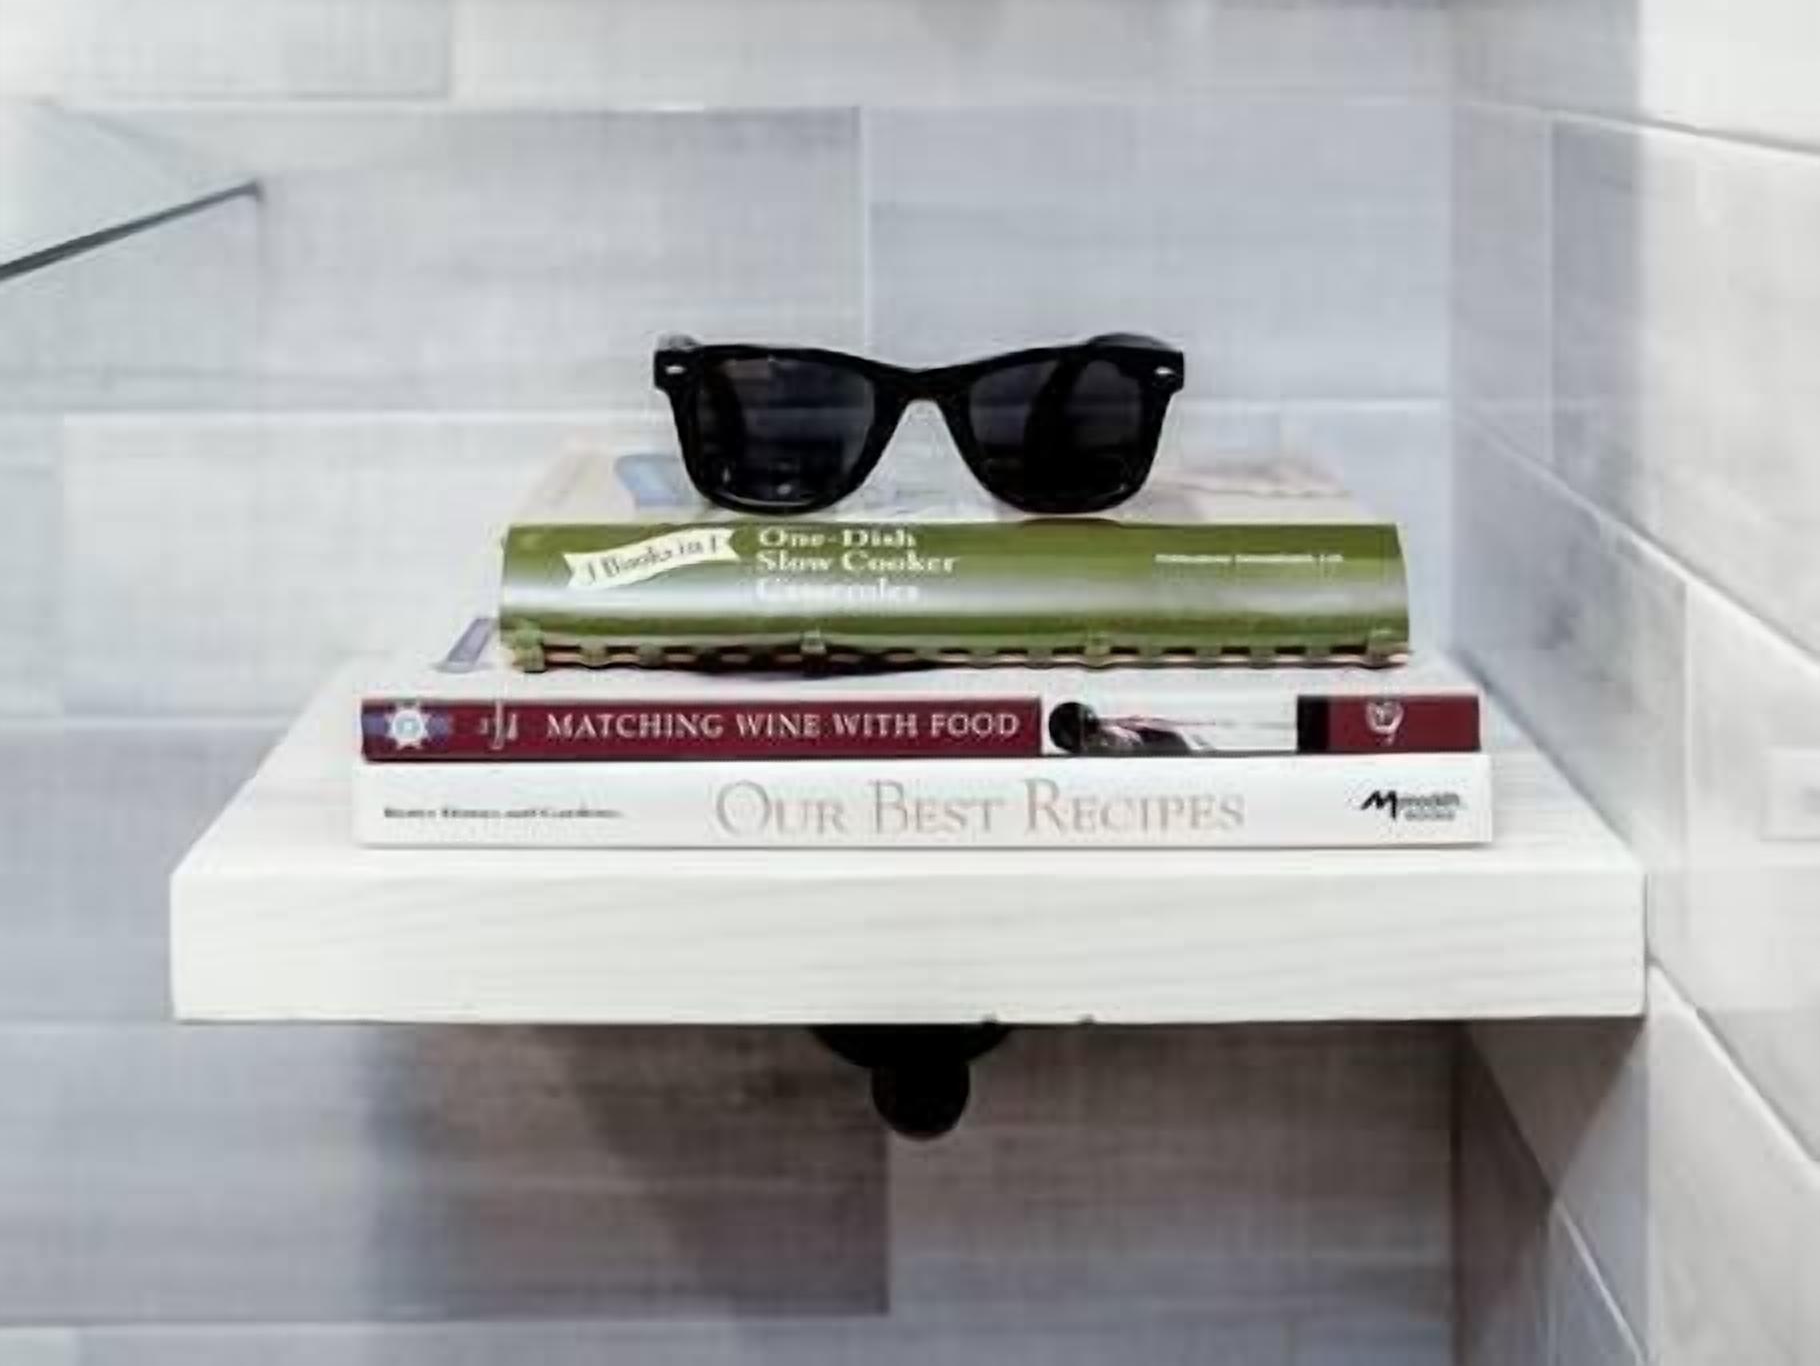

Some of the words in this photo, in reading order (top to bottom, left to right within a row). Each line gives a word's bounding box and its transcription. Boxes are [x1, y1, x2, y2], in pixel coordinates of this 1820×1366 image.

[758, 527, 916, 547] One-Dish
[756, 550, 832, 571] Slow
[841, 550, 960, 572] Cooker
[546, 712, 724, 739] MATCHING
[736, 712, 821, 738] WINE
[832, 712, 918, 738] WITH
[931, 711, 1021, 738] FOOD
